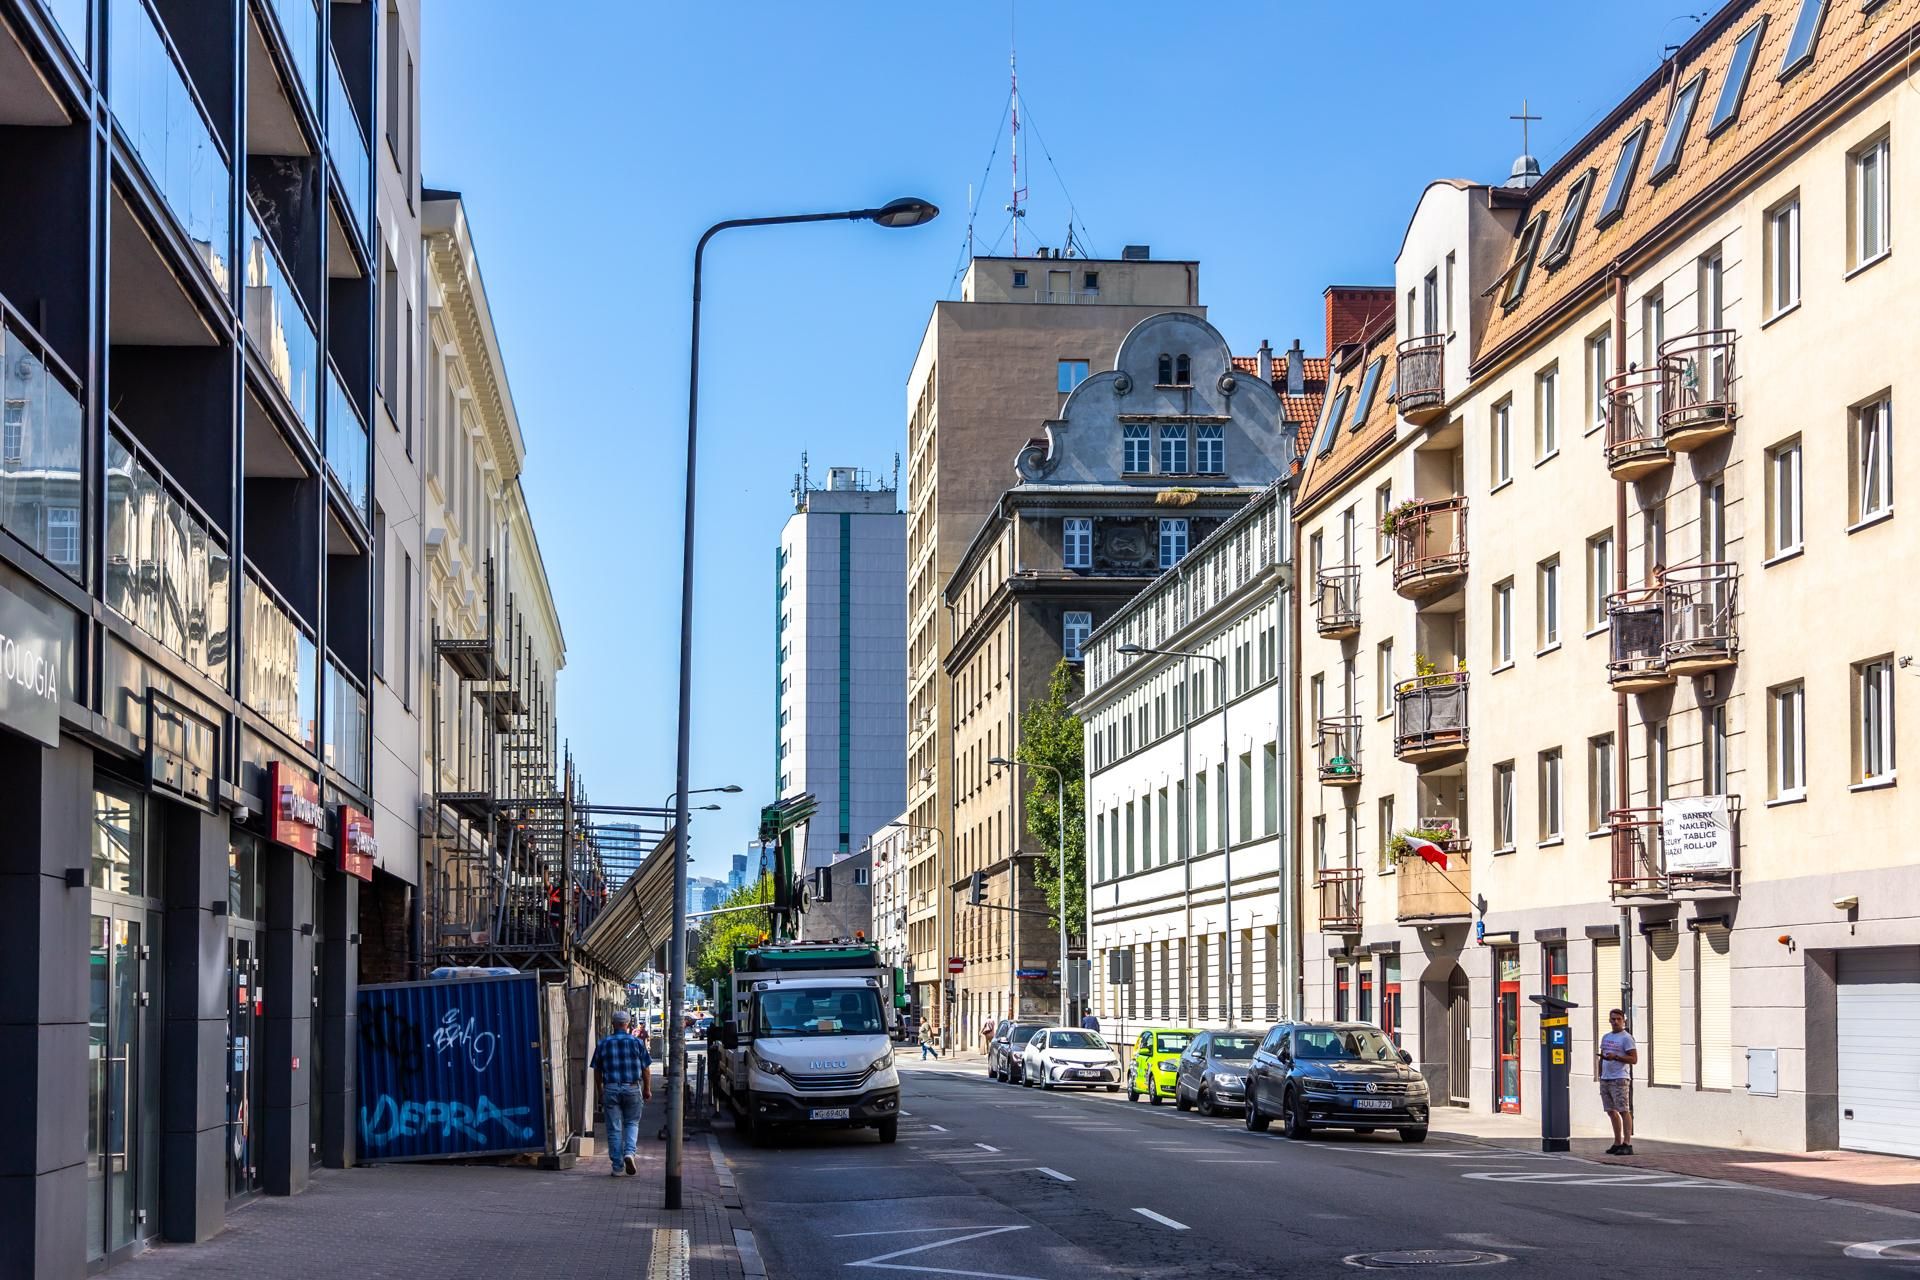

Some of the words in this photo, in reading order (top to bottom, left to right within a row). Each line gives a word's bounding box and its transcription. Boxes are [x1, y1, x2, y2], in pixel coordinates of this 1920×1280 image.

[0, 633, 57, 704] TOLOGIA
[1682, 811, 1713, 820] BANERY
[1680, 821, 1716, 830] NAKLEJKI
[1684, 831, 1717, 840] TABLICE
[1684, 841, 1717, 850] ROLL-UP
[1553, 1030, 1563, 1041] P
[809, 1059, 848, 1069] IVECO
